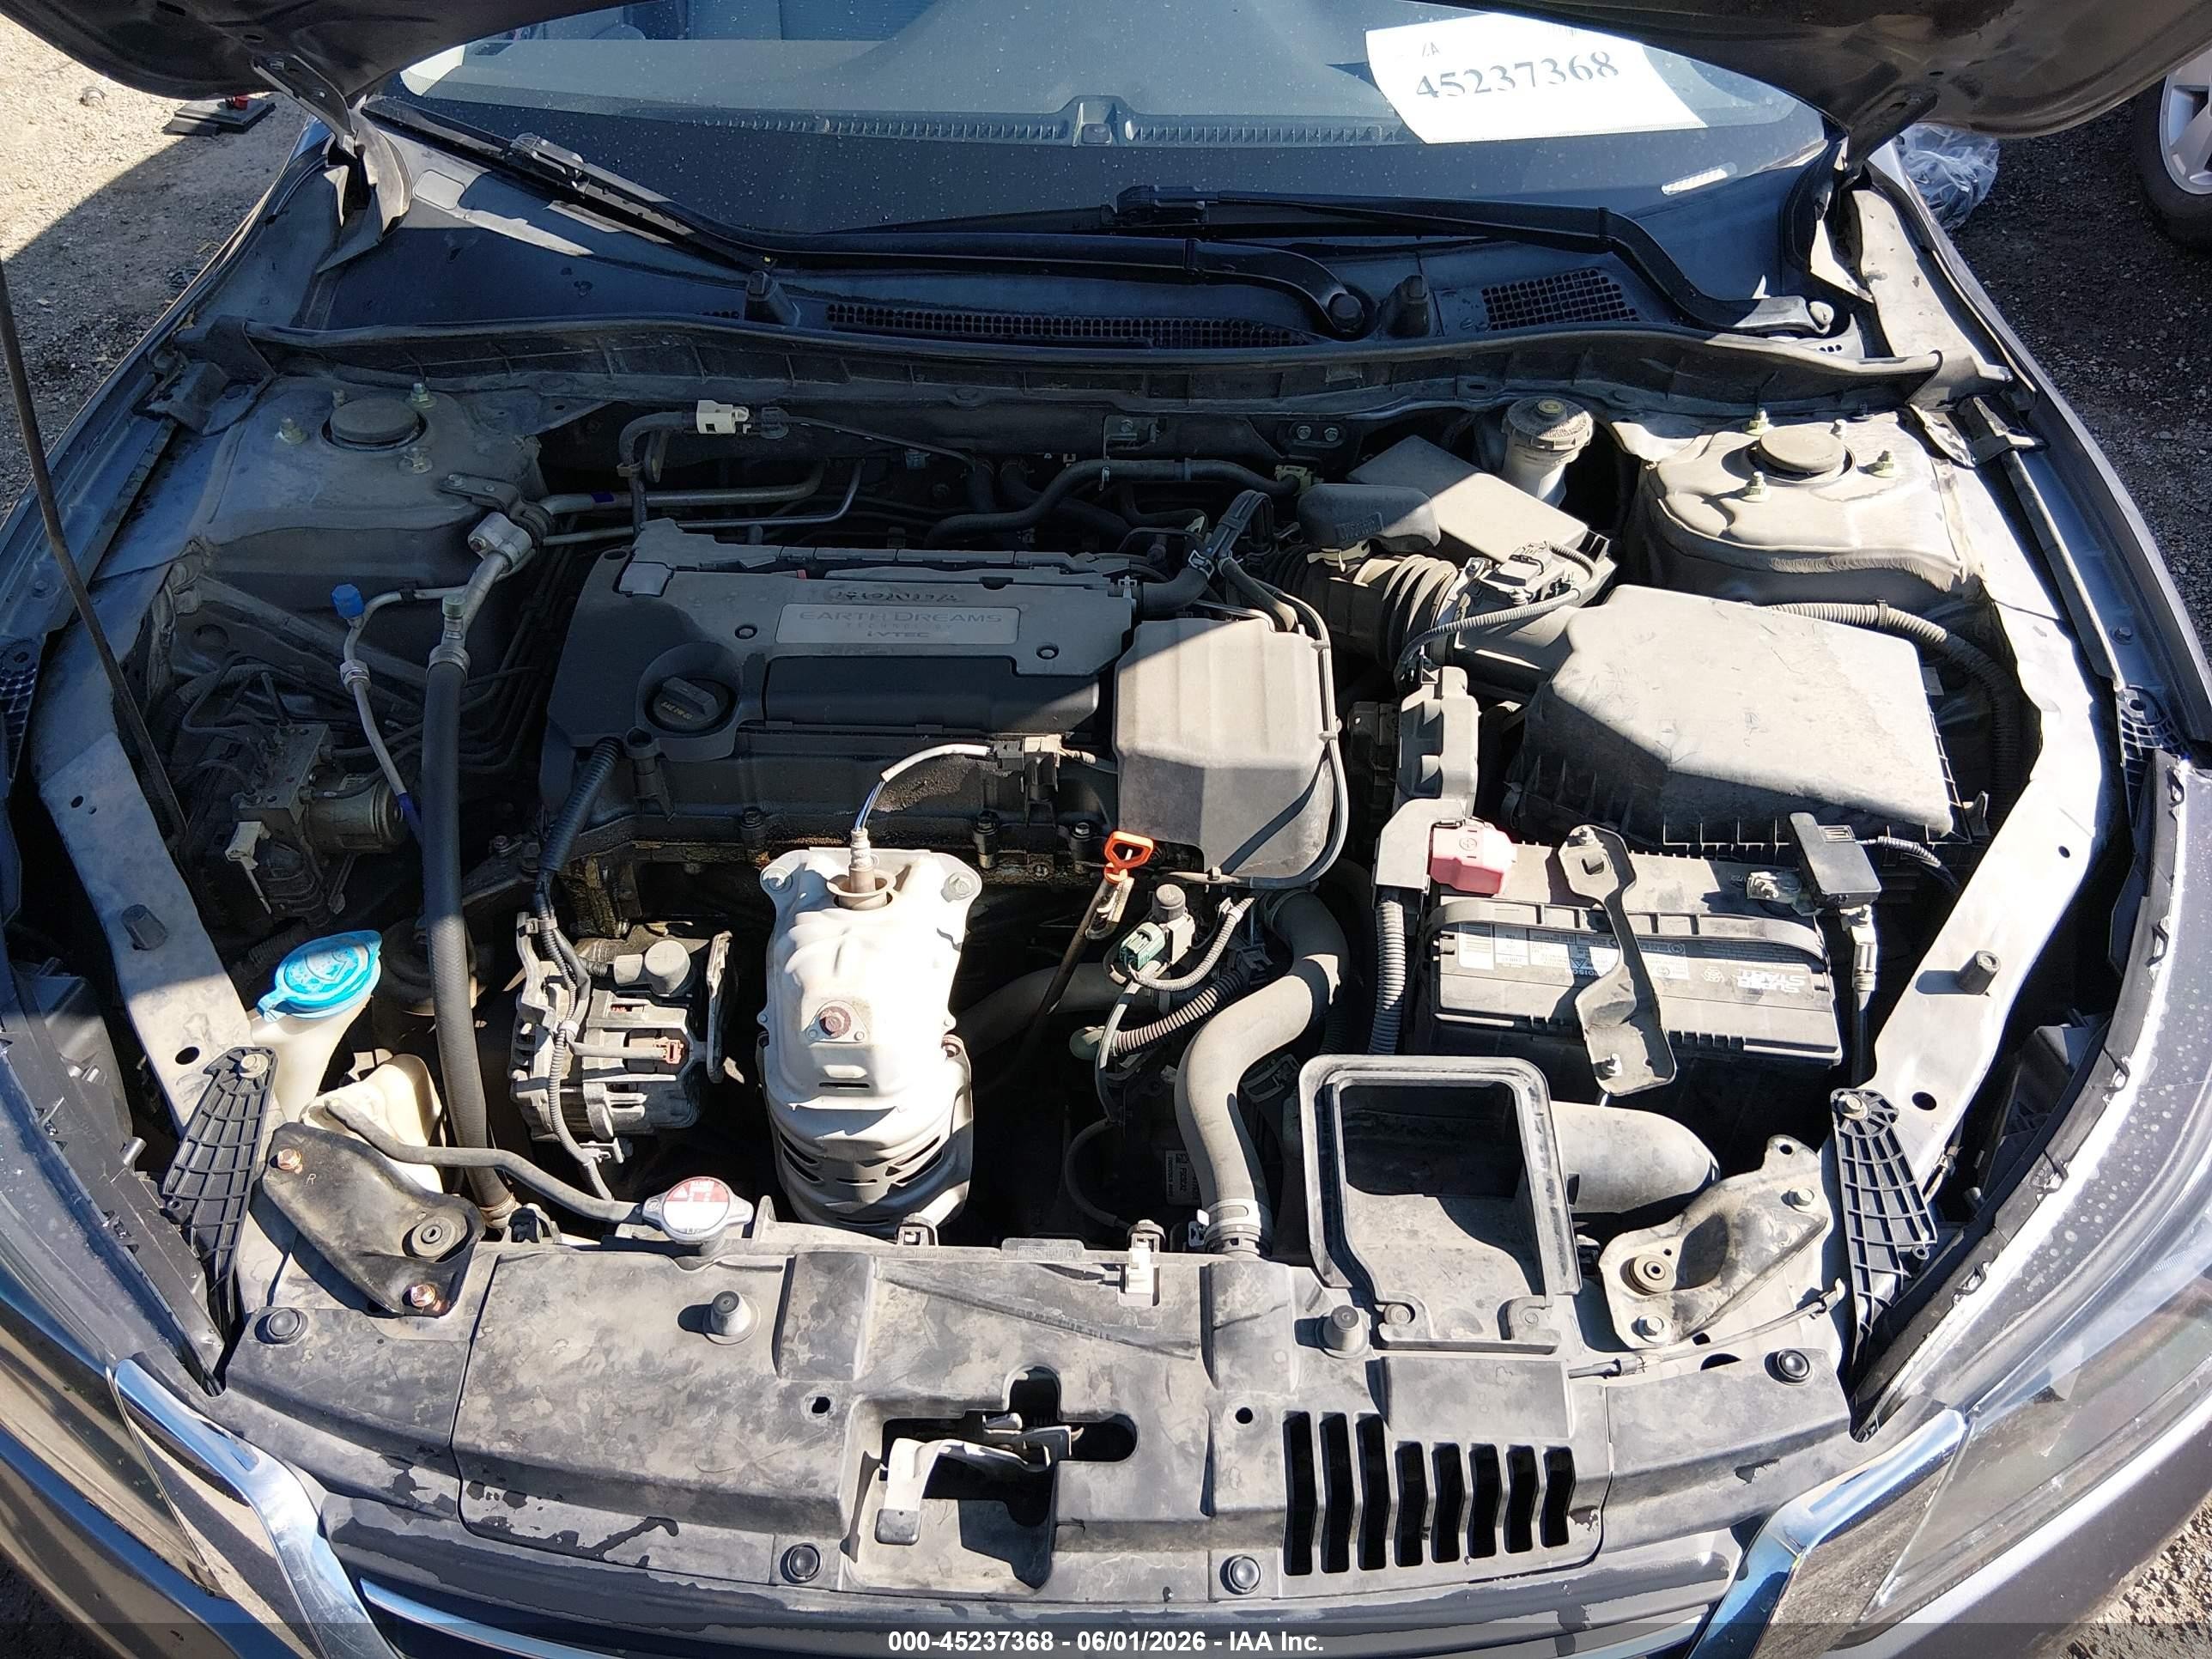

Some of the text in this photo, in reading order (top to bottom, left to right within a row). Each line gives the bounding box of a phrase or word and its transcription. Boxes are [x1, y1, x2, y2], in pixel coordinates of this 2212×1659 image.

[1416, 51, 1620, 98] 45237368
[799, 611, 1003, 623] EARTH DREAMS
